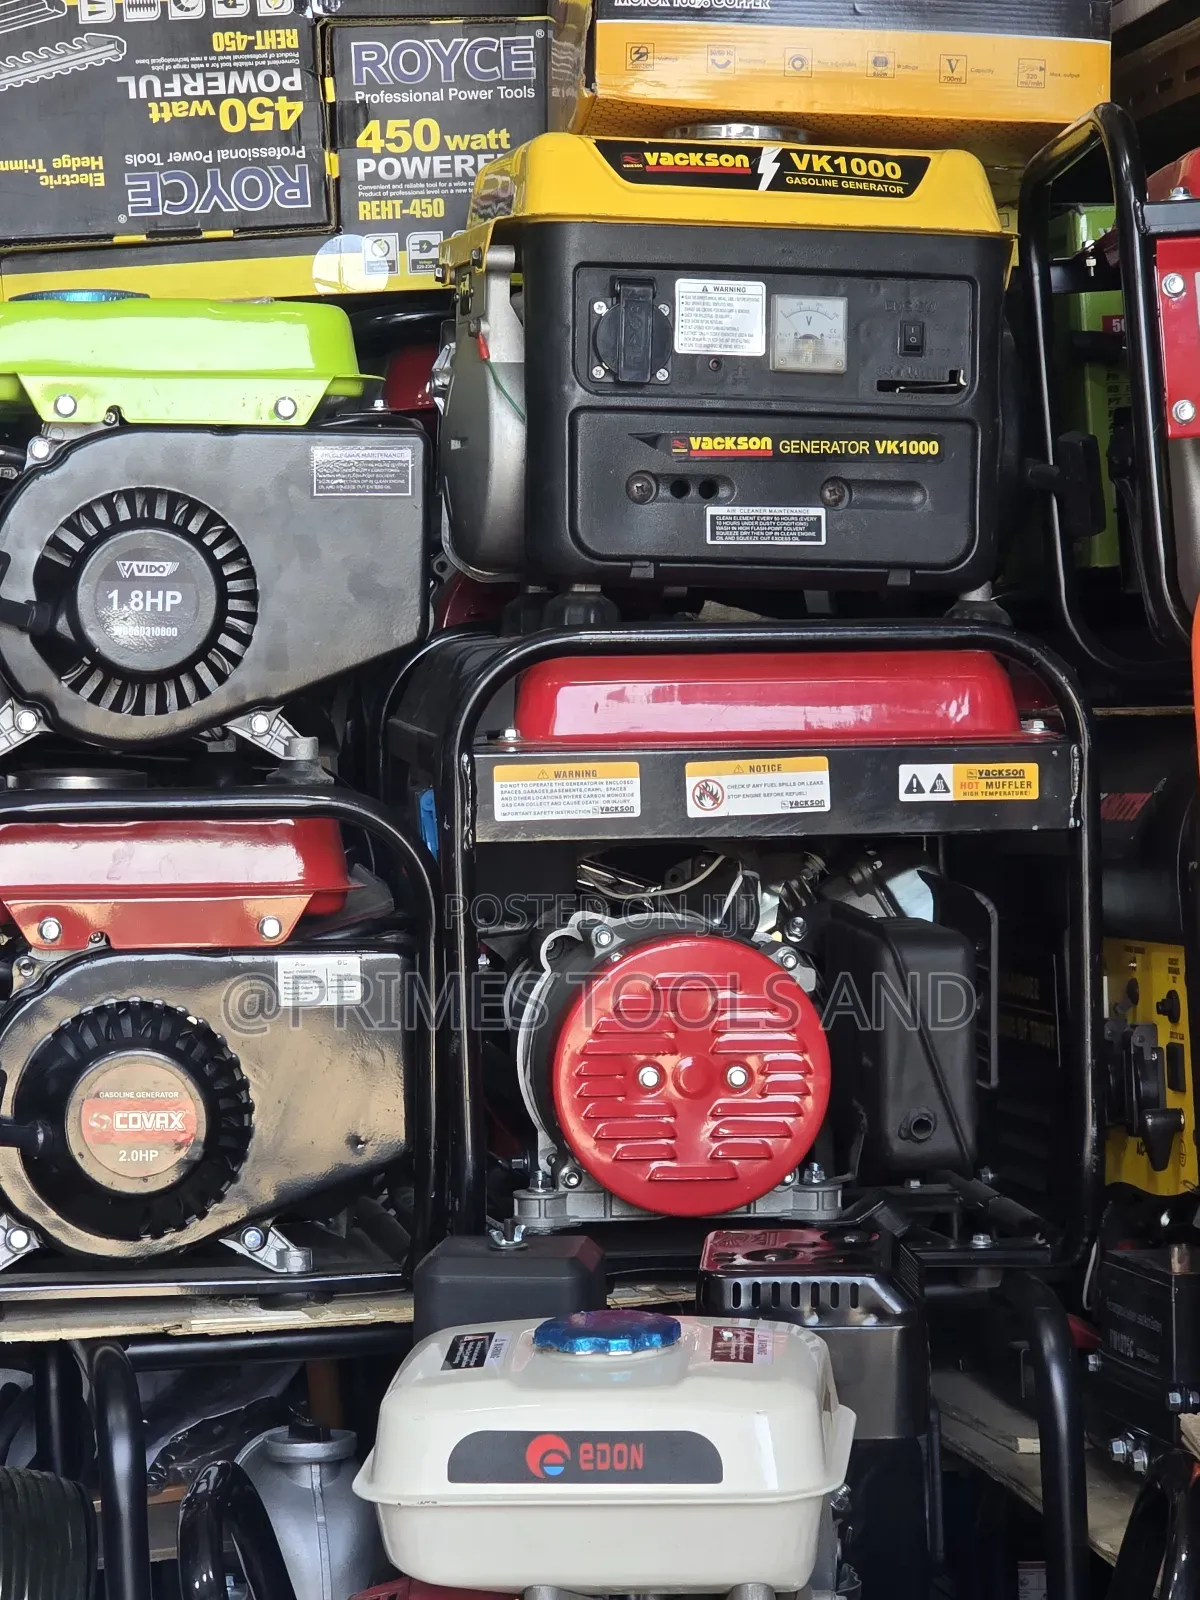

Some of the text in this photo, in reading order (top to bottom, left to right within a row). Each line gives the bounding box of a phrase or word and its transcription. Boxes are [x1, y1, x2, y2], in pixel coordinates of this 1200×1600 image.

[212, 29, 299, 51] REHT-450
[946, 59, 960, 74] V
[117, 68, 302, 99] POWERFUL
[355, 85, 535, 104] Professional Power Tools
[149, 97, 304, 132] 450 watt
[356, 118, 510, 154] 450 watt
[52, 154, 103, 171] Hedge
[125, 145, 306, 166] Professional Power Tools
[790, 152, 901, 180] VK1000
[40, 173, 105, 188] Electric
[786, 176, 904, 193] GASOLINE GENERATOR
[390, 189, 425, 197] professional
[358, 198, 445, 220] REHT-450
[805, 315, 813, 326] V
[779, 440, 869, 454] GENERATOR
[874, 440, 938, 455] VK1000
[136, 564, 165, 573] VIDO
[107, 589, 182, 612] 1.8HP
[553, 770, 597, 778] WARNING
[749, 764, 782, 772] NOTICE
[985, 781, 1032, 789] MUFFLER
[113, 1111, 185, 1131] COVAX
[118, 1150, 159, 1161] 2.0HP
